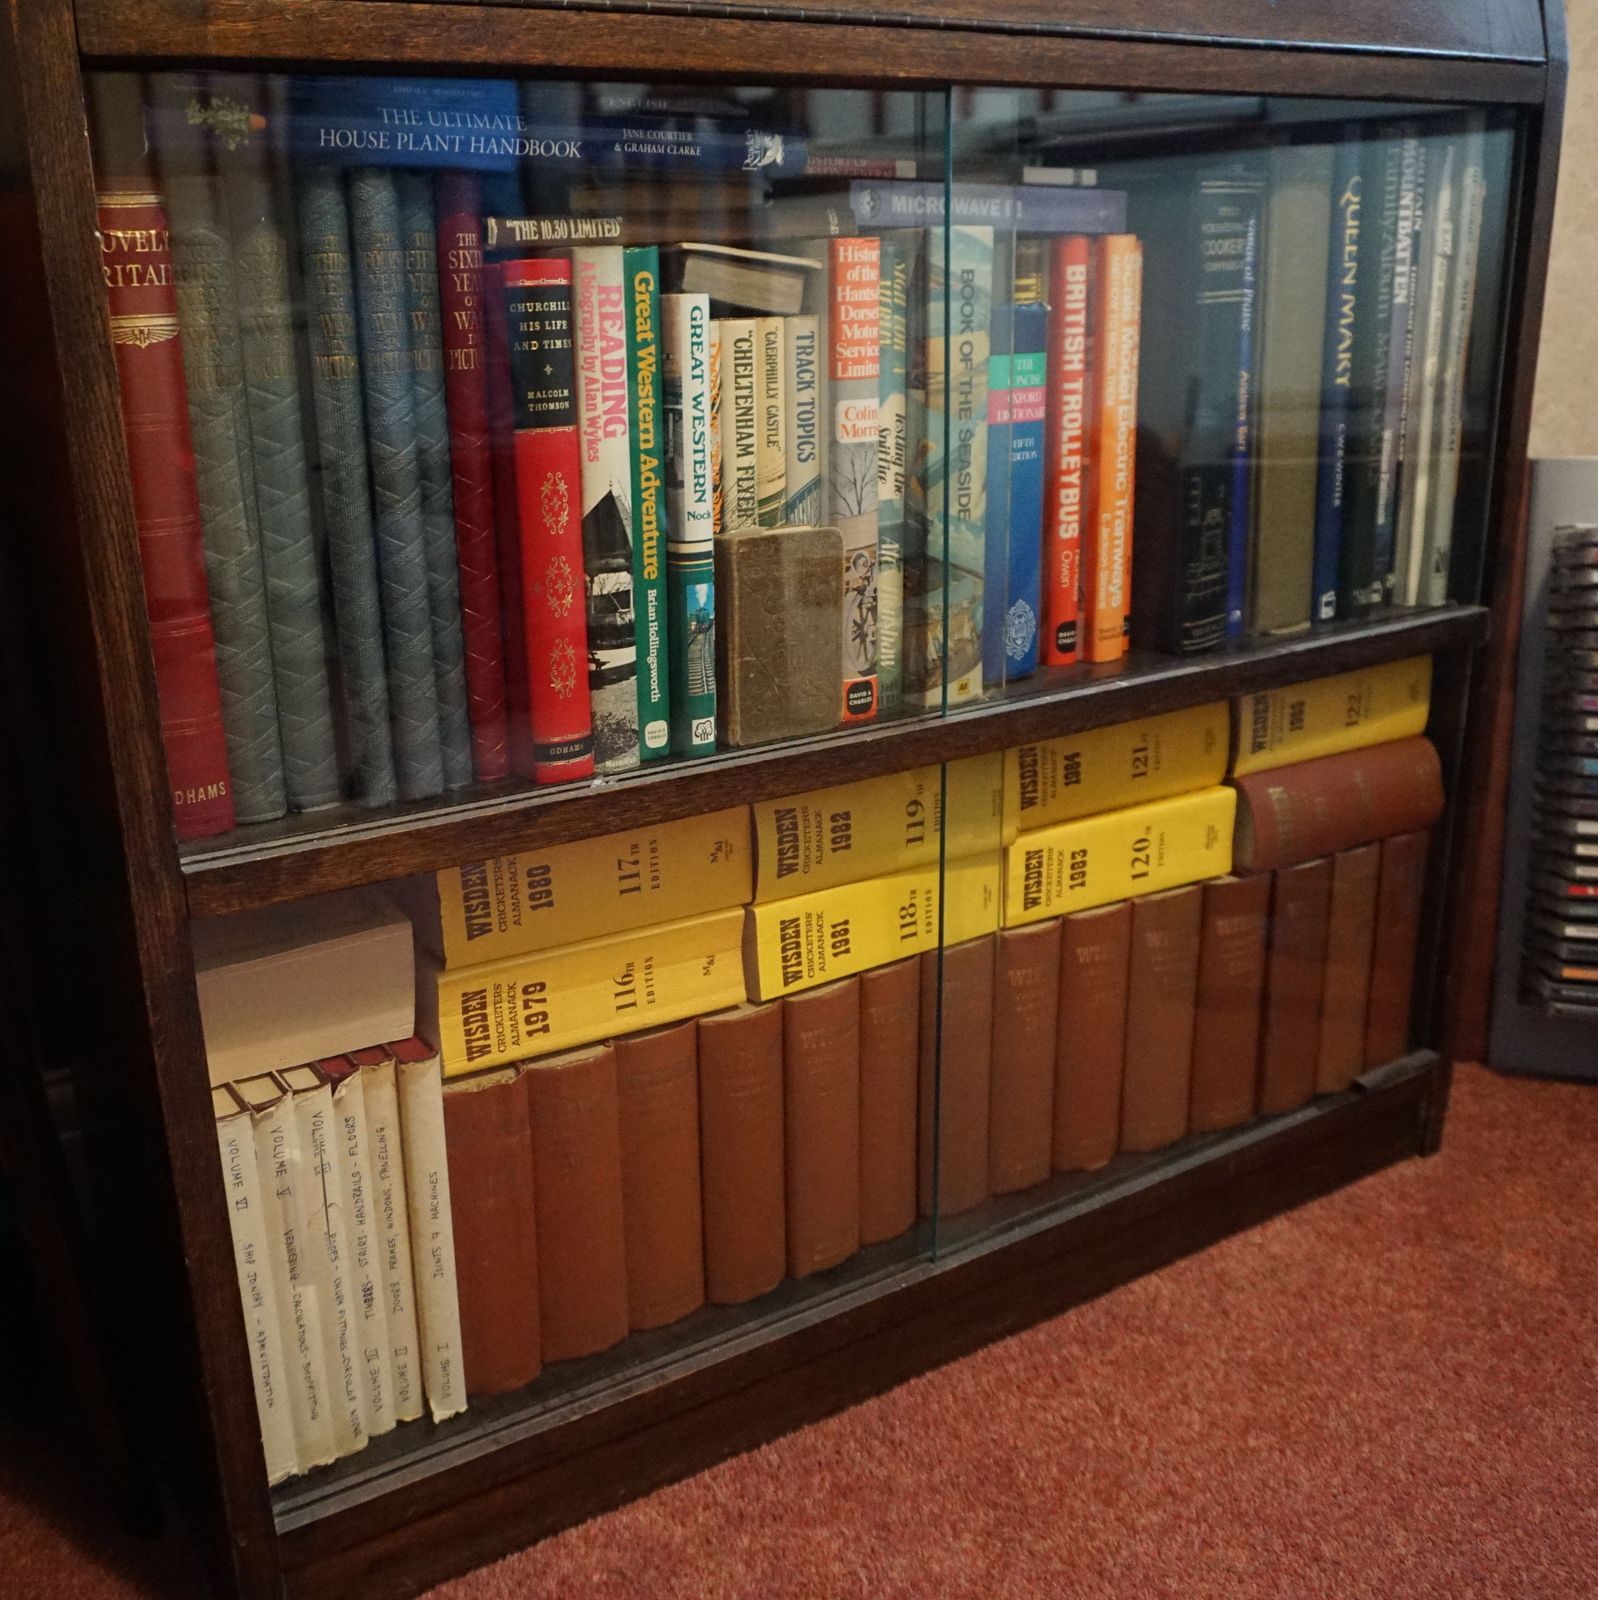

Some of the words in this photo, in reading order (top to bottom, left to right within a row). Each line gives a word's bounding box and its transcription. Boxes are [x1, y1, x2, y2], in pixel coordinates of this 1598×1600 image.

[319, 128, 391, 150] HOUSE
[396, 131, 465, 153] PLANT
[470, 136, 582, 158] HANDBOOK
[377, 107, 423, 127] THE
[427, 110, 528, 133] ULTIMATE
[622, 127, 645, 140] JANE
[646, 129, 694, 142] COURTIER
[624, 143, 665, 155] GRAHAM
[667, 145, 702, 157] CLARKE
[541, 219, 568, 241] 10.30
[1339, 175, 1362, 285] QUEEN
[1393, 139, 1418, 305] MOUNTBATTEN
[580, 260, 597, 272] A
[847, 266, 861, 282] of
[861, 264, 878, 281] the
[1122, 255, 1137, 321] Scale
[519, 321, 541, 332] HIS
[545, 319, 568, 331] LIFE
[580, 275, 600, 350] biography
[634, 270, 656, 342] Great
[959, 268, 975, 336] BOOK
[1064, 264, 1087, 372] BRITISH
[513, 340, 540, 351] AND
[690, 304, 704, 384] GREAT
[841, 323, 880, 340] Motor
[959, 340, 974, 371] OF
[1335, 294, 1357, 388] MARY
[583, 352, 599, 374] by
[597, 283, 628, 440] READING
[796, 331, 815, 393] TRACK
[1120, 327, 1135, 400] Model
[527, 388, 570, 400] MALCOLM
[527, 401, 570, 412] THOMSON
[583, 375, 600, 413] Alan
[636, 344, 658, 450] Western
[844, 406, 878, 421] Colin
[958, 376, 974, 422] THE
[585, 417, 604, 464] Wykes
[692, 391, 708, 504] WESTERN
[797, 398, 816, 464] TOPICS
[1115, 404, 1132, 491] Electric
[957, 427, 973, 521] SEASIDE
[1058, 378, 1083, 540] TROLLEYBUS
[639, 453, 661, 581] Adventure
[687, 509, 712, 522] Nock
[1060, 549, 1074, 588] Owen
[1111, 500, 1128, 609] Tramways
[646, 588, 658, 620] Brian
[648, 621, 662, 704] Hollingsworth
[849, 692, 866, 701] DAVID
[1063, 751, 1082, 787] 1984
[774, 806, 800, 880] WISDEN
[830, 810, 852, 854] 1982
[815, 809, 824, 866] ALMANACK
[649, 838, 661, 891] EDITION
[1023, 848, 1045, 912] WISDEN
[1069, 847, 1088, 891] 1983
[1056, 848, 1065, 898] ALMANACK
[459, 860, 494, 942] WISDEN
[526, 862, 555, 912] 1980
[511, 854, 523, 927] ALMANACK
[924, 888, 933, 935] EDITION
[779, 916, 804, 988] WISDEN
[830, 918, 851, 959] 1981
[816, 910, 827, 973] ALMANACK
[646, 955, 657, 1006] EDITION
[460, 987, 493, 1063] WISDEN
[521, 980, 551, 1039] 1979
[506, 981, 521, 1047] ALMANACK
[270, 1125, 288, 1178] VOLUME
[344, 1114, 359, 1157] FLOORS
[225, 1138, 244, 1189] VOLUME
[235, 1197, 248, 1212] VI
[276, 1186, 292, 1200] V
[352, 1171, 367, 1227] HANDRAILS
[429, 1170, 440, 1220] MACHINES
[357, 1231, 369, 1267] STAIRS
[431, 1246, 445, 1279] JOINTS
[394, 1345, 408, 1357] II
[368, 1369, 384, 1413] VOLUME
[397, 1363, 411, 1404] VOLUME
[439, 1360, 452, 1401] VOLUME
